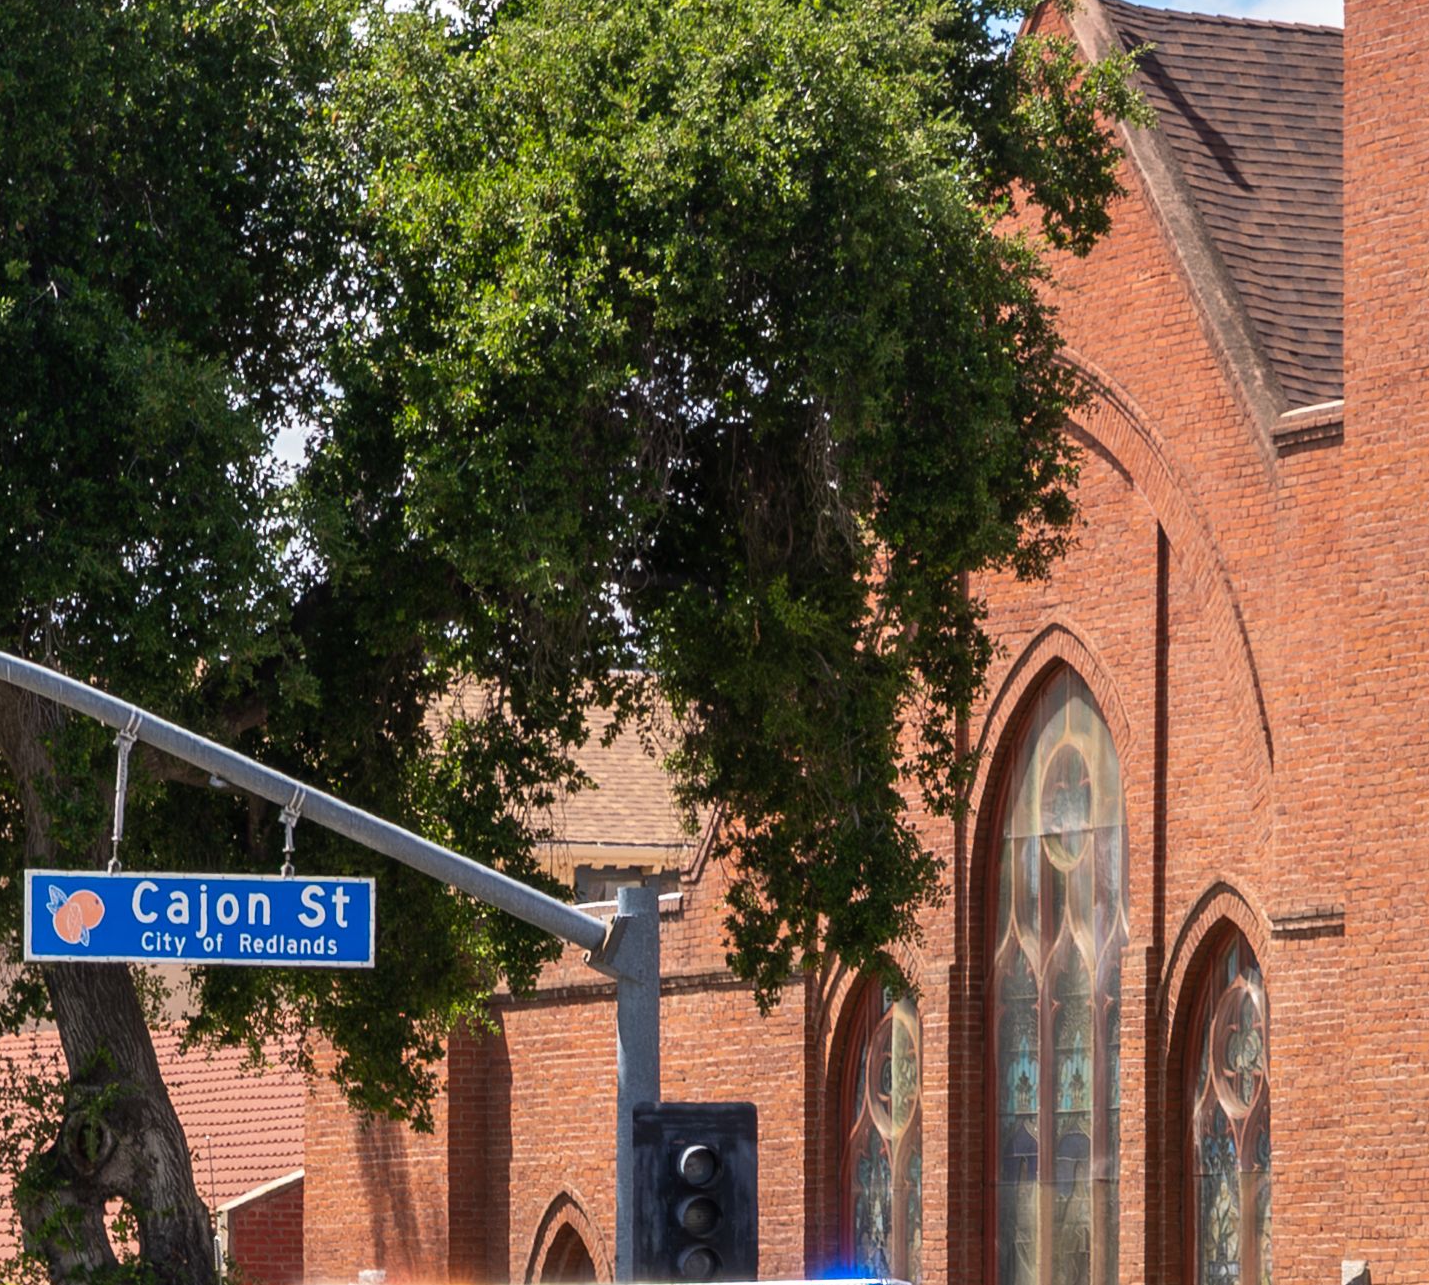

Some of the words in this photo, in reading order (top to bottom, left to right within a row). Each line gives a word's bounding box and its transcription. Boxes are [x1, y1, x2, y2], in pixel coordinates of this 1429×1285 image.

[131, 880, 272, 939] Cajon
[297, 884, 351, 929] St
[141, 931, 186, 957] City
[202, 933, 223, 954] of
[239, 934, 338, 956] Redlands
